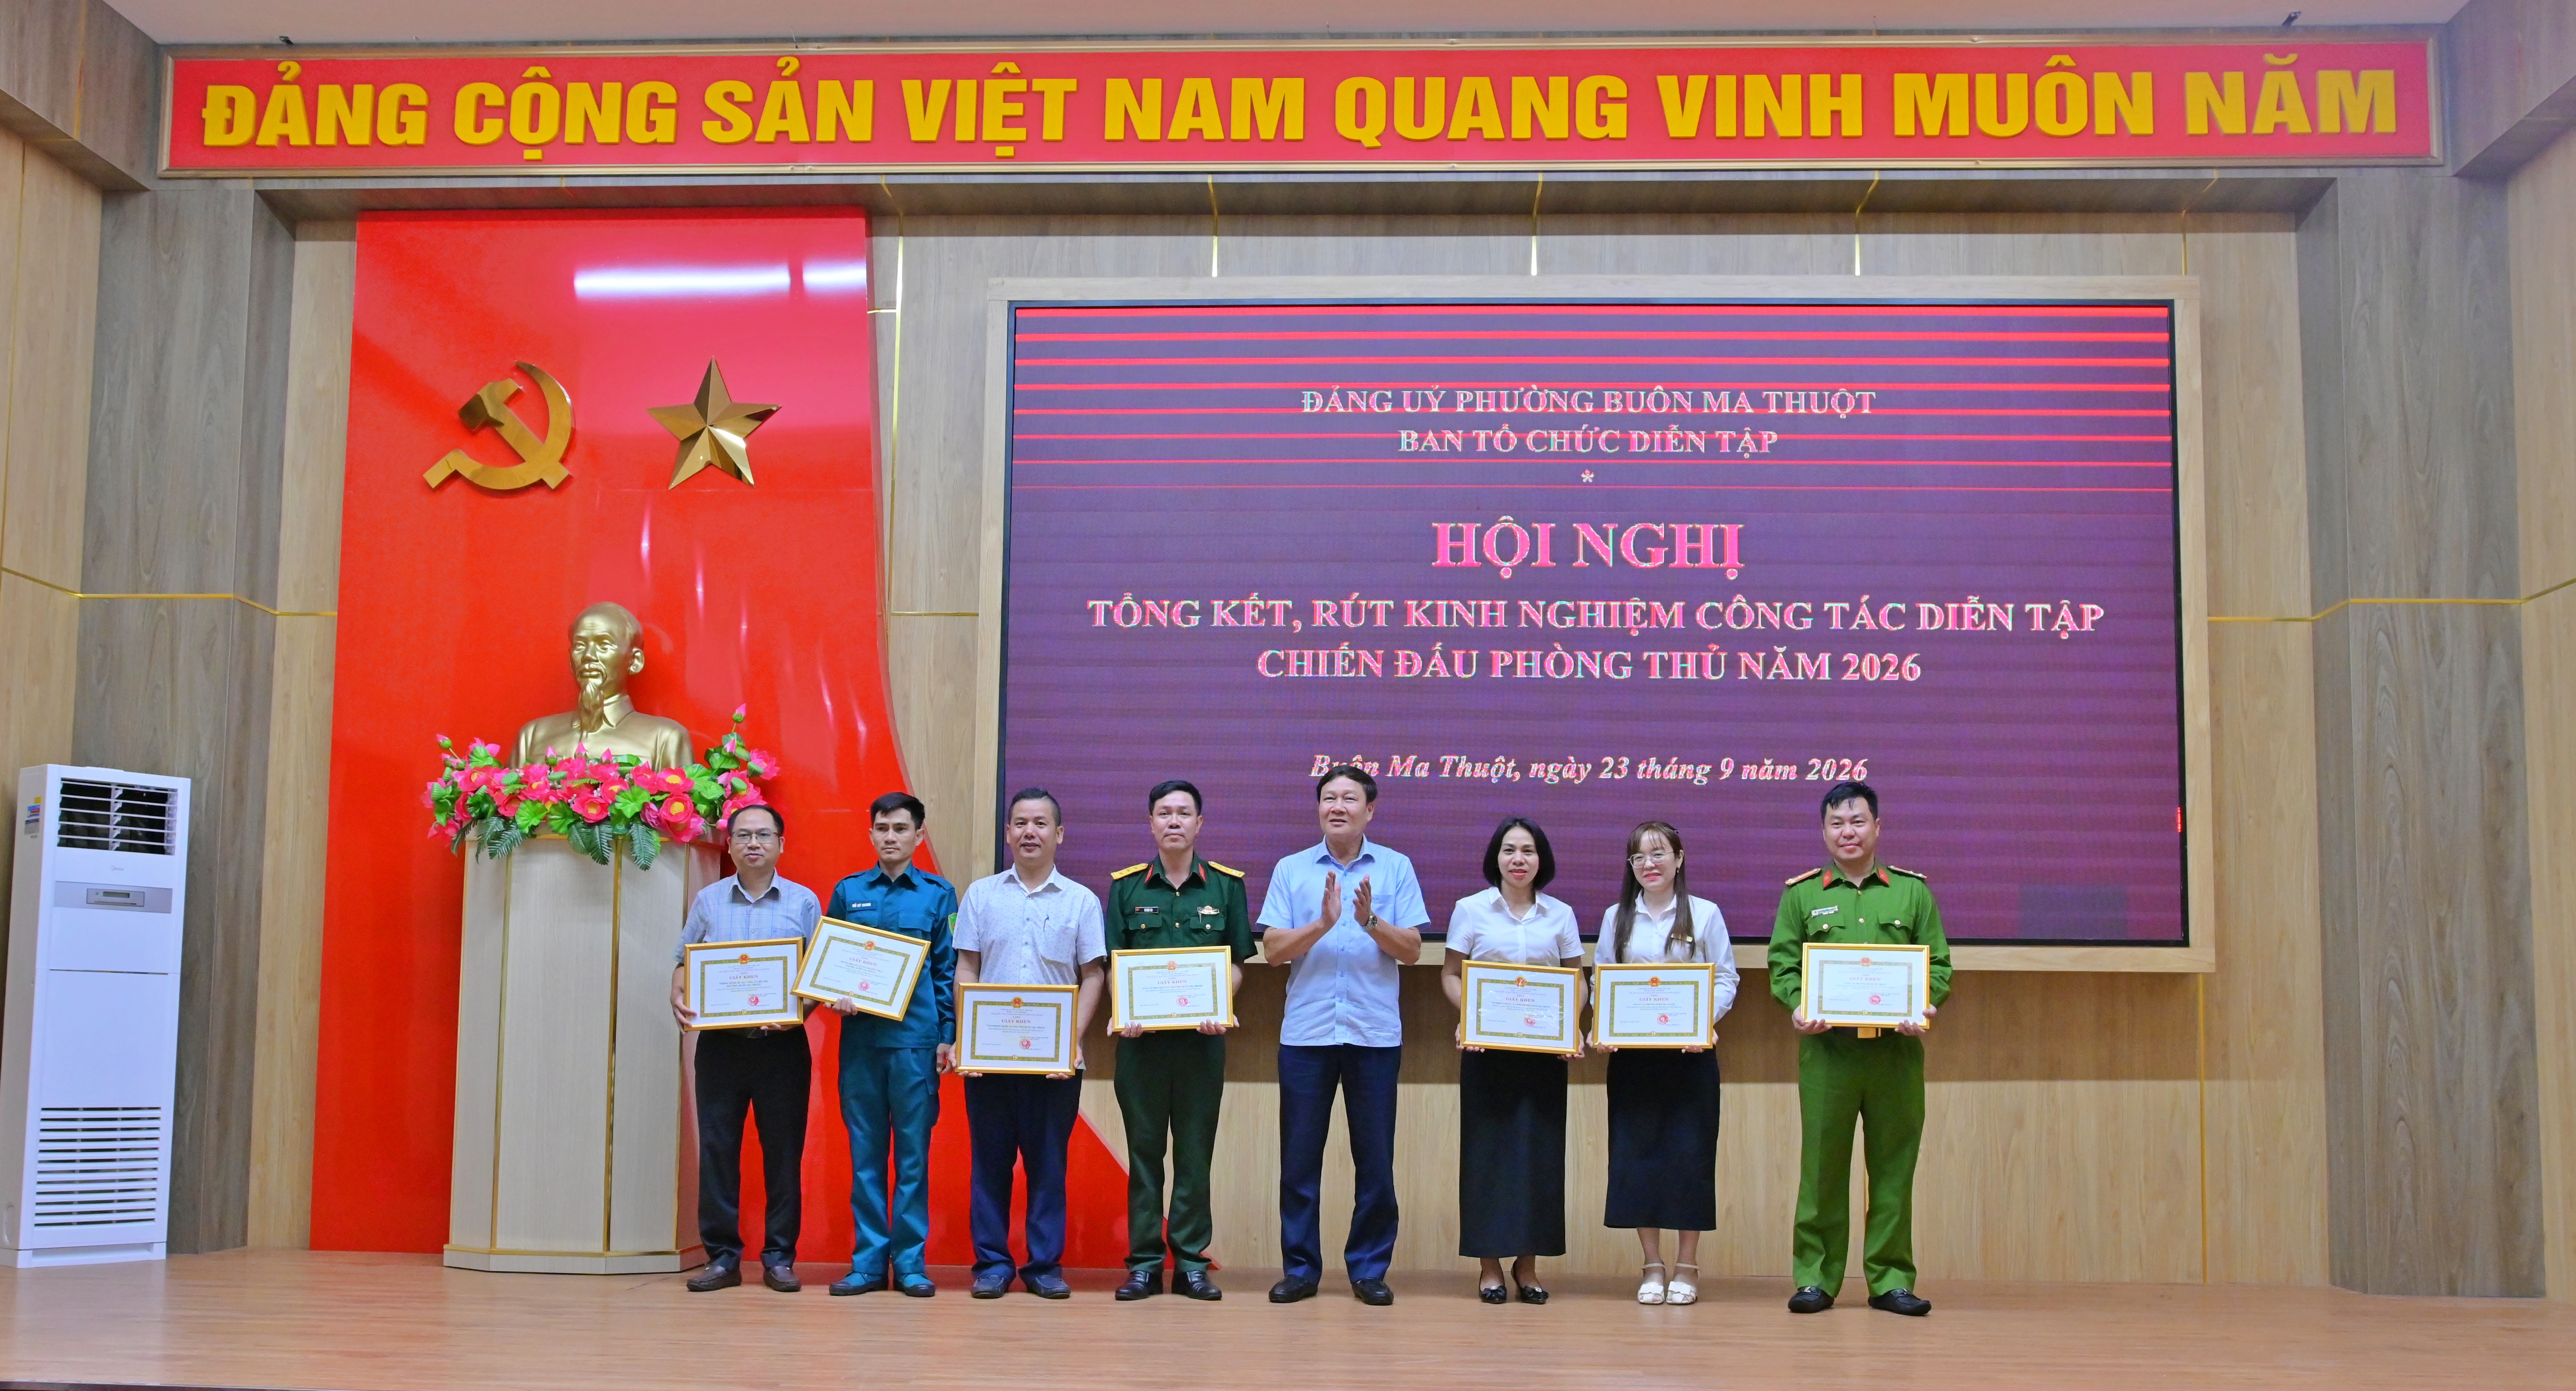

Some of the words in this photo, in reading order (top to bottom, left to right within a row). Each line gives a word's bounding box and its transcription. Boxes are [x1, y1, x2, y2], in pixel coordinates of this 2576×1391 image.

[202, 60, 429, 147] ĐẢNG
[454, 66, 678, 161] CỘNG
[702, 56, 875, 144] SẢN
[901, 62, 1078, 158] VIỆT
[1105, 78, 1305, 141] NAM
[1335, 75, 1628, 149] QUANG
[1656, 74, 1863, 139] VINH
[1894, 55, 2155, 138] MUÔN
[2185, 53, 2397, 135] NĂM
[1301, 384, 1392, 413] ĐẢNG
[1455, 384, 1594, 413] PHƯỜNG
[1603, 384, 1693, 413] BUÔN
[1702, 391, 1755, 413] MA
[1762, 388, 1876, 419] THUỘT
[1398, 429, 1464, 452] BAN
[1472, 423, 1518, 452] TỔ
[1526, 423, 1620, 453] CHỨC
[1629, 423, 1706, 453] DIỄN
[1715, 426, 1778, 459] TẬP
[1432, 515, 1556, 580] HỘI
[1572, 522, 1745, 581] NGHỊ
[1087, 592, 1202, 628] TỔNG
[1210, 592, 1303, 633] KẾT,
[1312, 592, 1395, 628] RÚT
[1404, 600, 1509, 629] KINH
[1517, 598, 1687, 638] NGHIỆM
[1695, 594, 1814, 631] CÔNG
[1824, 594, 1906, 632] TÁC
[1916, 595, 2015, 632] DIỄN
[2025, 599, 2105, 640] TẬP
[1257, 641, 1385, 678] CHIẾN
[1394, 642, 1479, 679] ĐẤU
[1489, 643, 1633, 680] PHÒNG
[1643, 643, 1728, 681] THỦ
[1737, 646, 1832, 681] NĂM
[1841, 652, 1921, 682] 2026
[1386, 754, 1431, 777] Ma
[1439, 755, 1521, 784] Thuột,
[1529, 756, 1592, 785] ngày
[1599, 756, 1630, 780] 23
[1637, 757, 1713, 786] tháng
[1720, 757, 1734, 780] 9
[1742, 758, 1799, 781] năm
[1805, 758, 1869, 782] 2026
